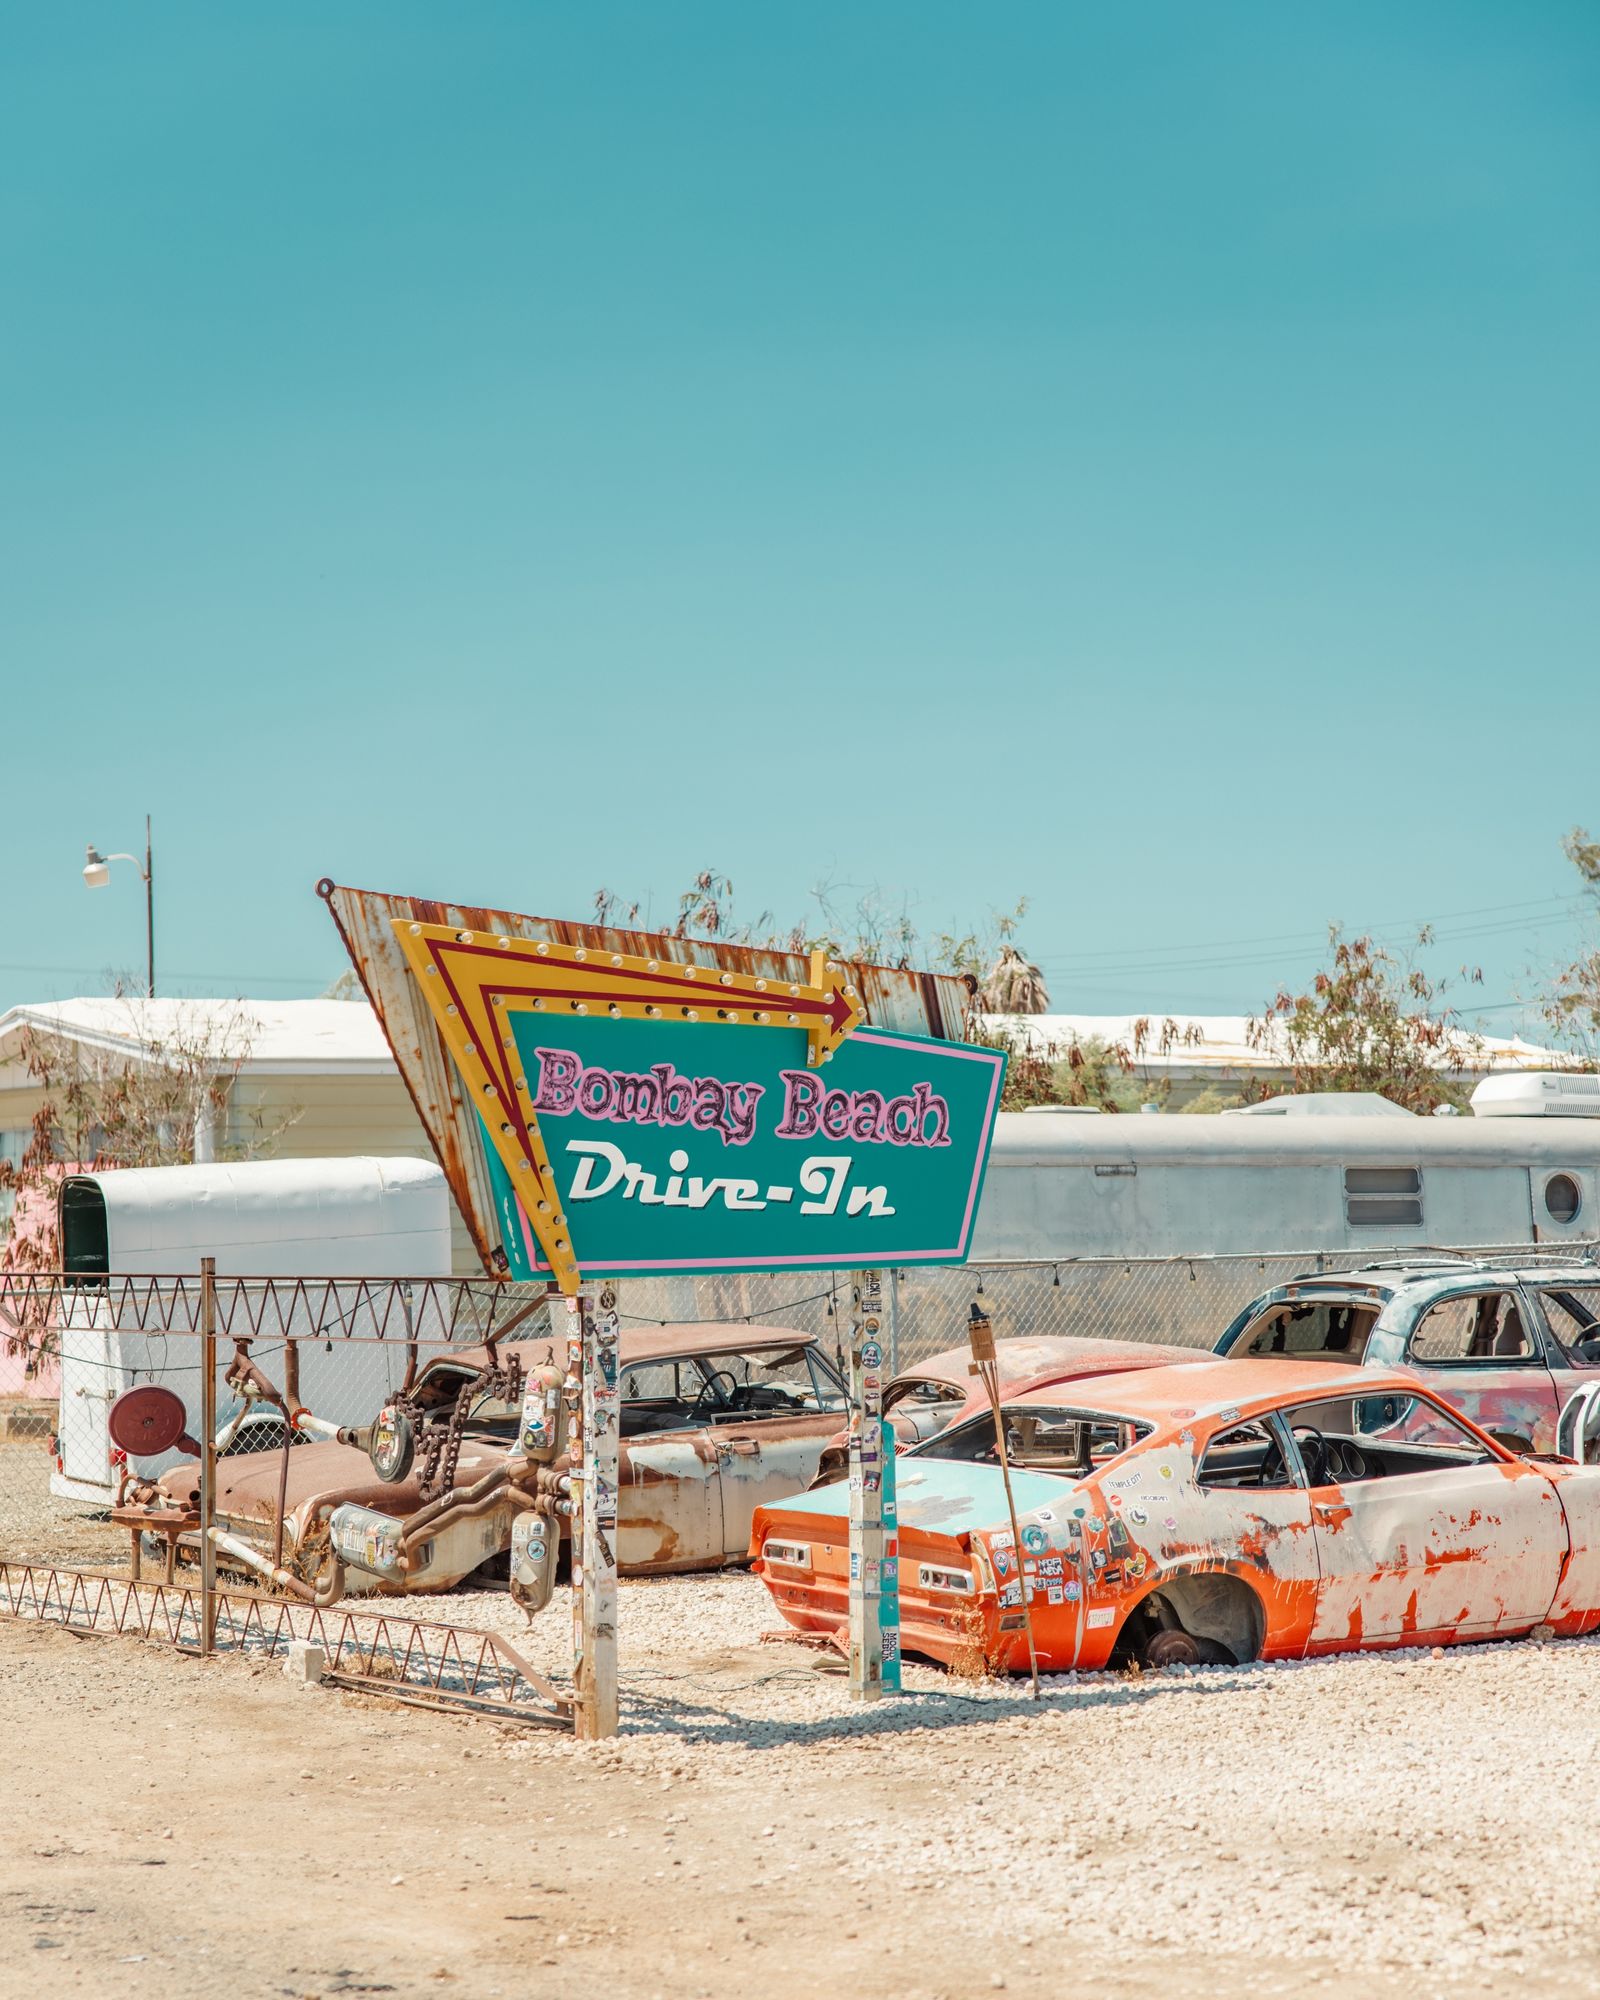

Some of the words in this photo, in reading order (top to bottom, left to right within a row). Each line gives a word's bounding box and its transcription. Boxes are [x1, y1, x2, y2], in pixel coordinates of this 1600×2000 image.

[533, 1047, 766, 1146] Bombay
[774, 1069, 953, 1148] Beach
[565, 1140, 896, 1217] Drive-In
[1108, 1479, 1131, 1489] TEMPLE
[1131, 1472, 1142, 1485] CITY
